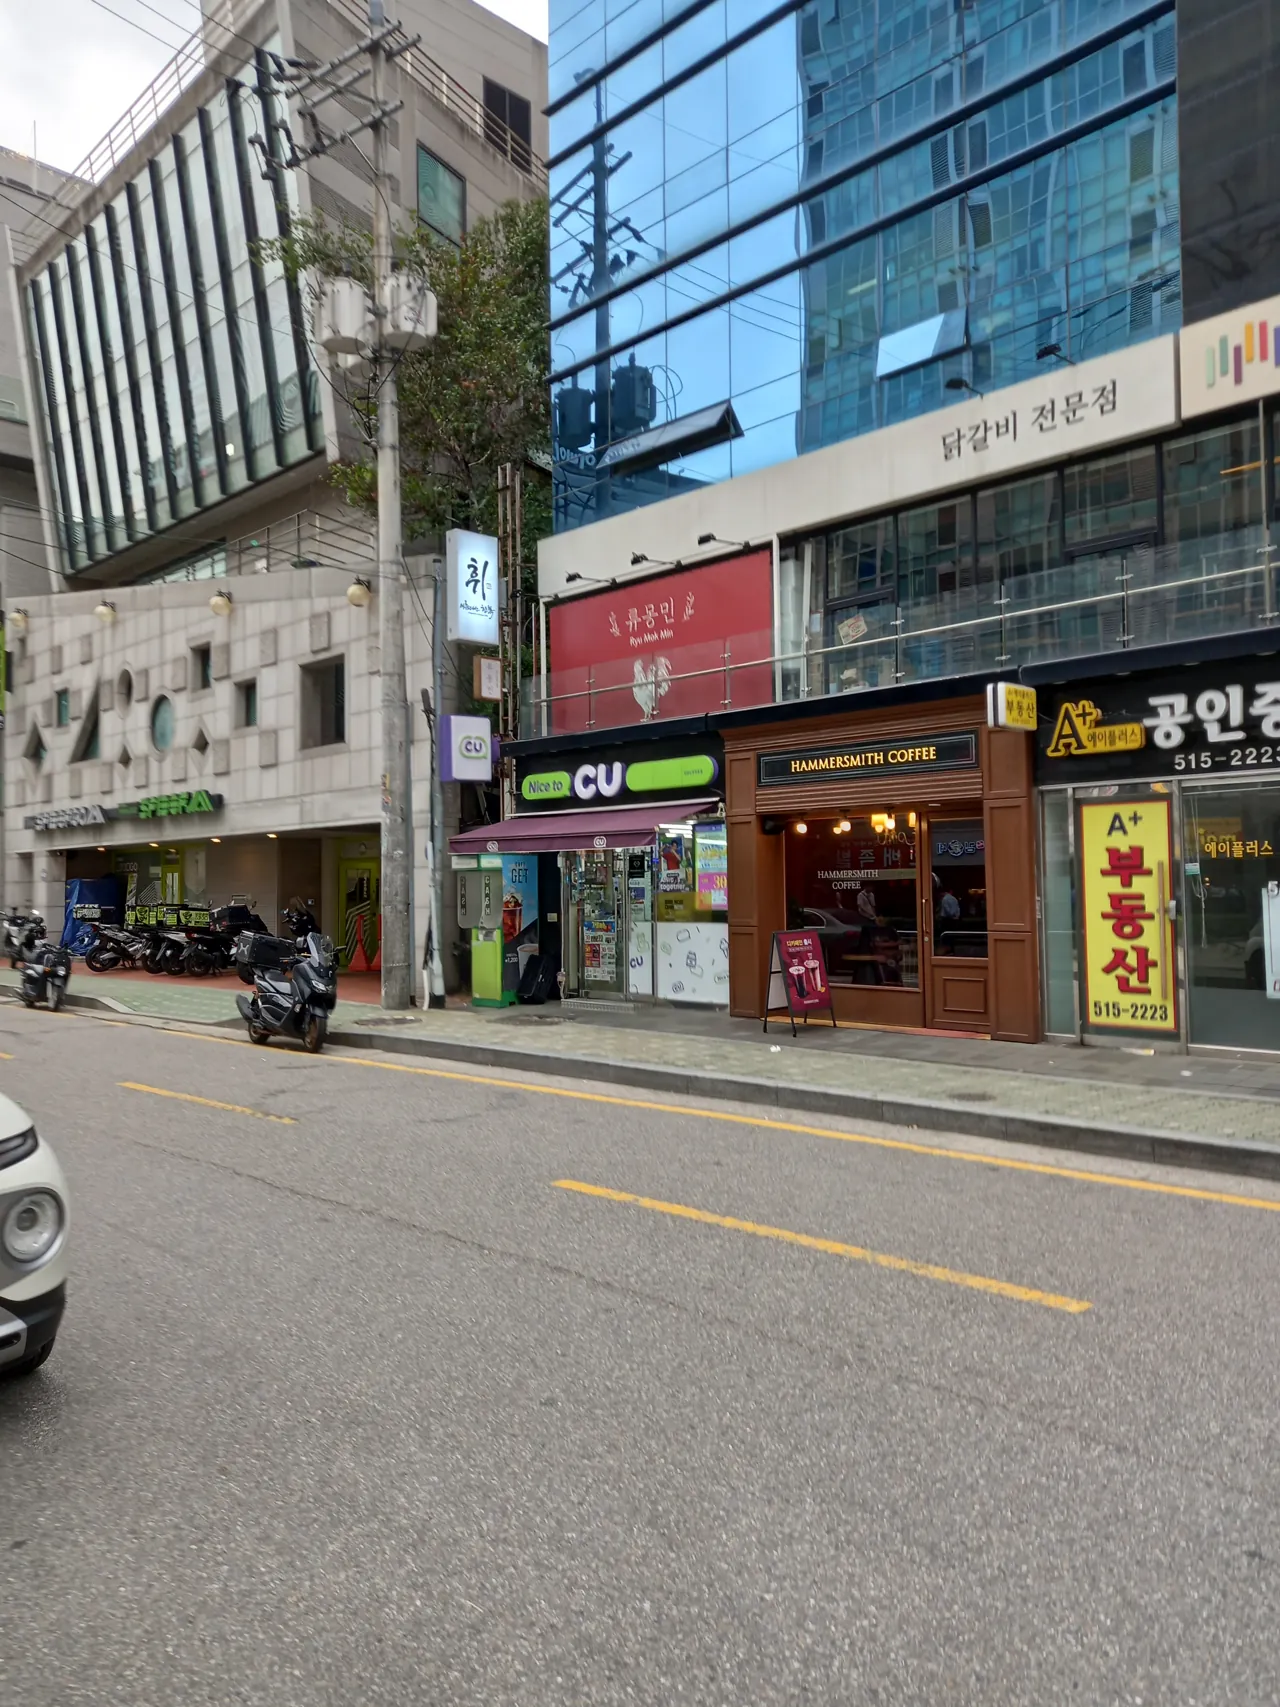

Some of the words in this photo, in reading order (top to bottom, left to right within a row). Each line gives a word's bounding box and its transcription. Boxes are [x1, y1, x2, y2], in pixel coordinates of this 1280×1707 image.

[941, 409, 1017, 461] 닭갈비
[1031, 378, 1117, 433] 전문점
[465, 557, 489, 601] 휘
[630, 635, 643, 648] Ryu
[660, 627, 674, 640] Min
[1006, 699, 1035, 719] 부동산
[1143, 680, 1280, 749] 공인중
[1050, 702, 1096, 755] A+
[1087, 728, 1140, 748] 에이플러스
[465, 741, 482, 752] CU
[791, 752, 884, 772] HAMMERSMITH
[887, 746, 937, 763] COFFEE
[528, 780, 550, 794] Nice
[552, 779, 563, 792] to
[574, 760, 624, 800] CU
[1107, 810, 1142, 837] A+
[1204, 840, 1274, 858] 에이플러스
[511, 868, 528, 884] GET
[817, 869, 879, 879] HAMMERSMITH
[832, 881, 861, 890] COFFEE
[1100, 845, 1158, 995] 부동산
[629, 955, 644, 969] CU
[1093, 1001, 1169, 1022] 515-2223
